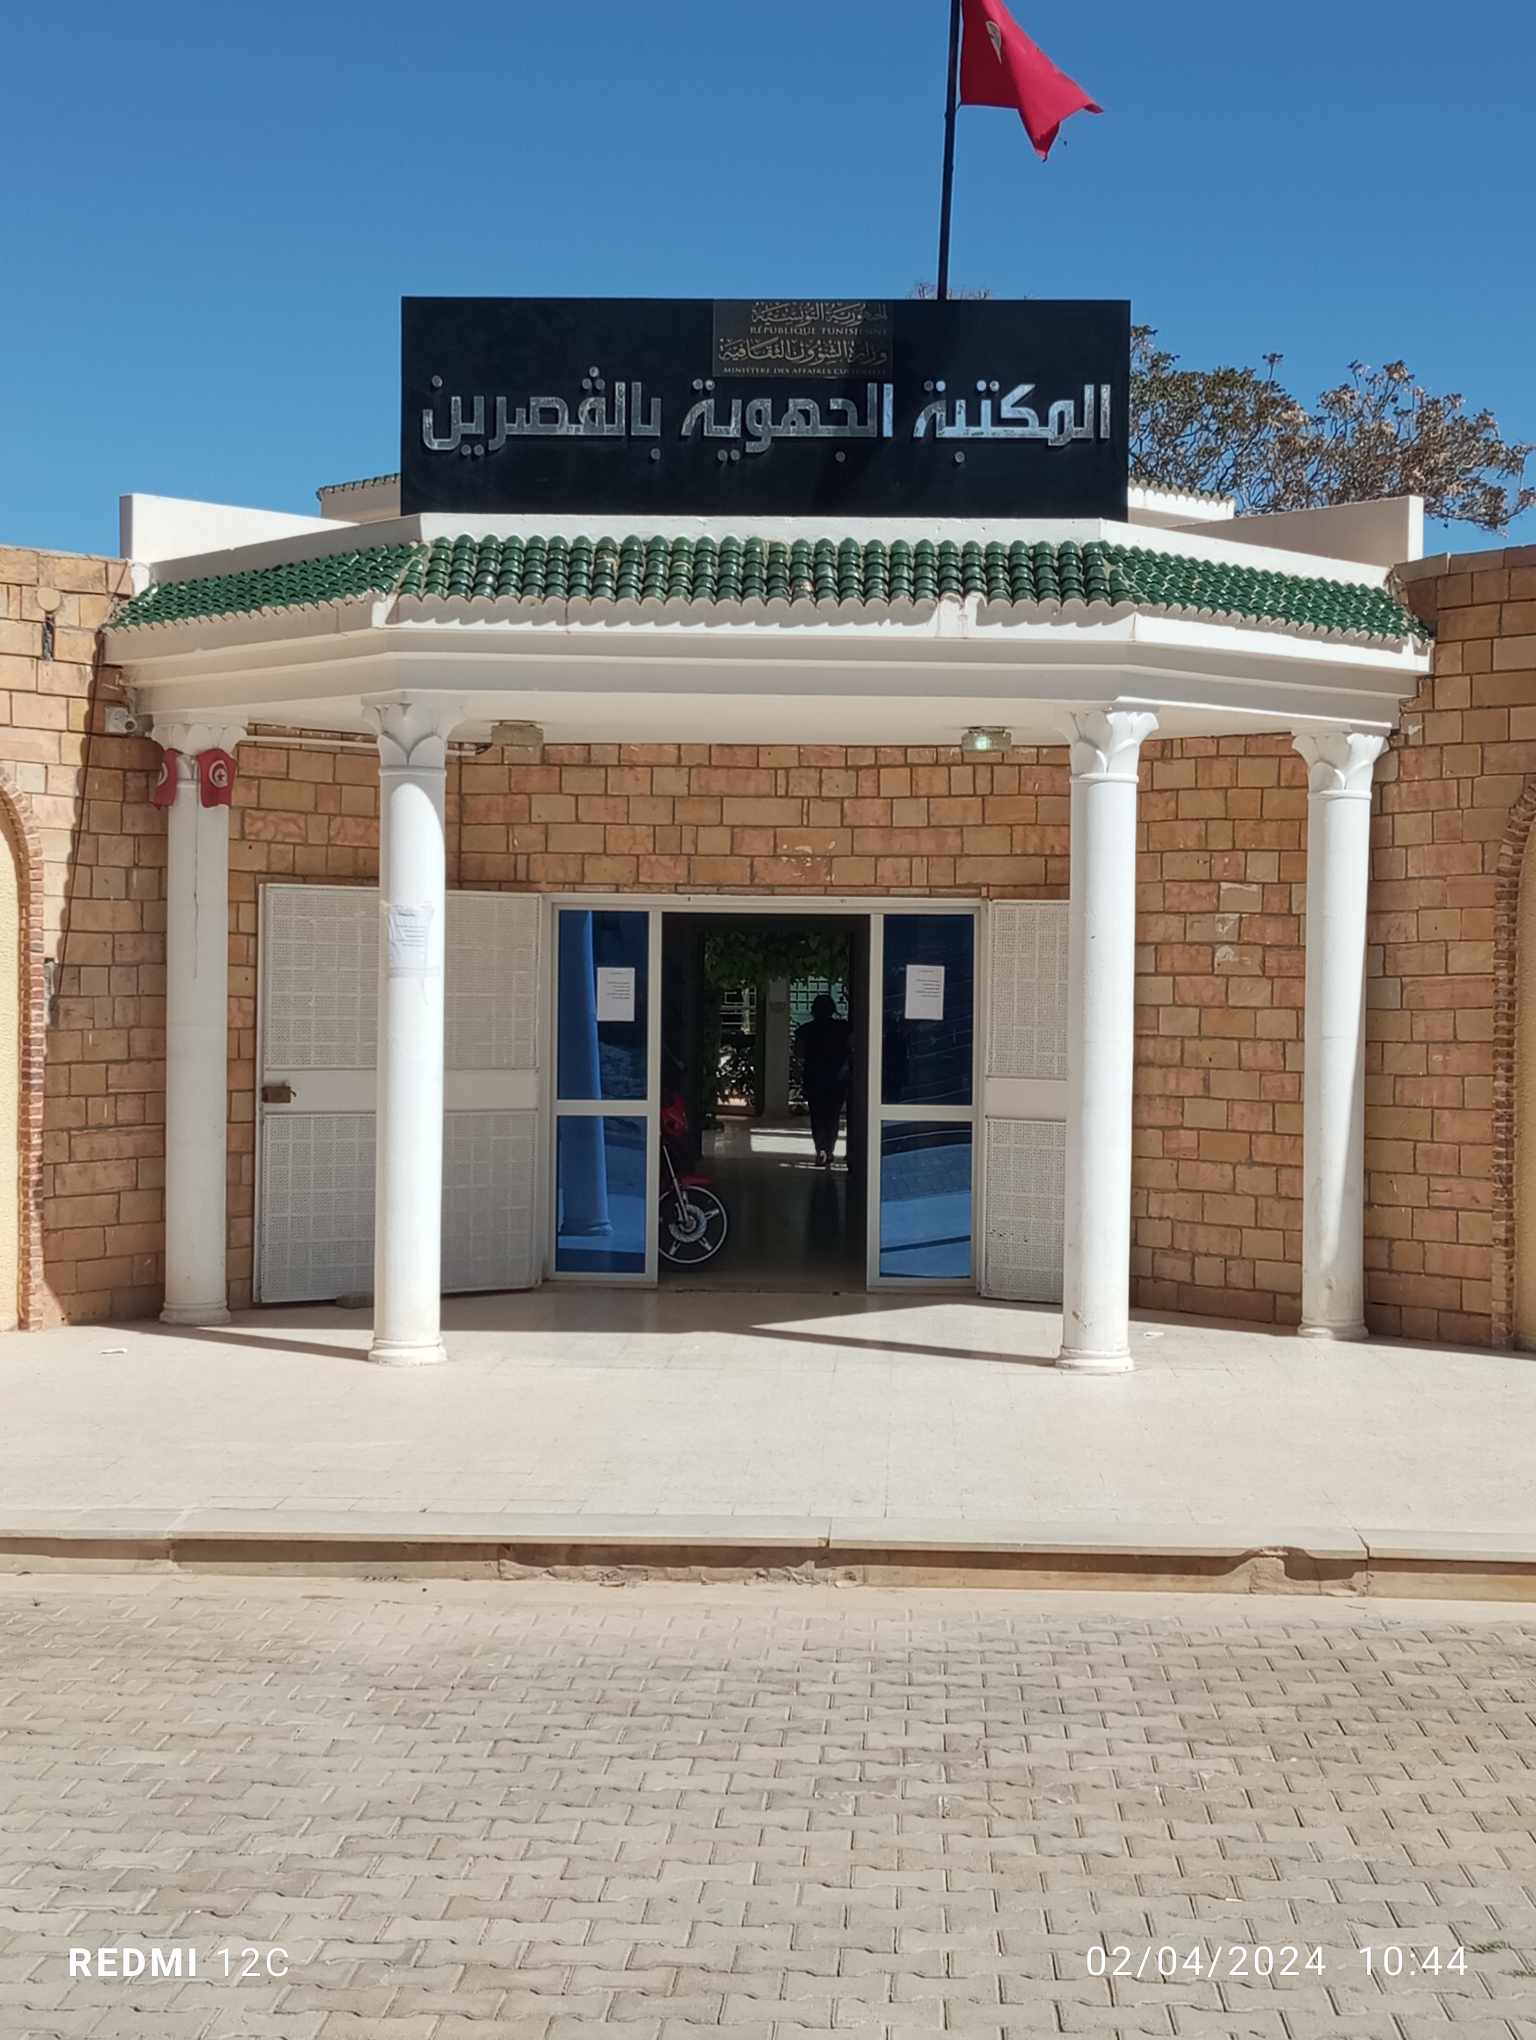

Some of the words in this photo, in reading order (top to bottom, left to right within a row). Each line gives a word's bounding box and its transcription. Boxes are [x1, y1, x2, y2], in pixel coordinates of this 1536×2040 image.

[422, 366, 661, 460] بالقصرين
[681, 378, 894, 463] الجهوية
[913, 379, 1112, 463] المكتبة
